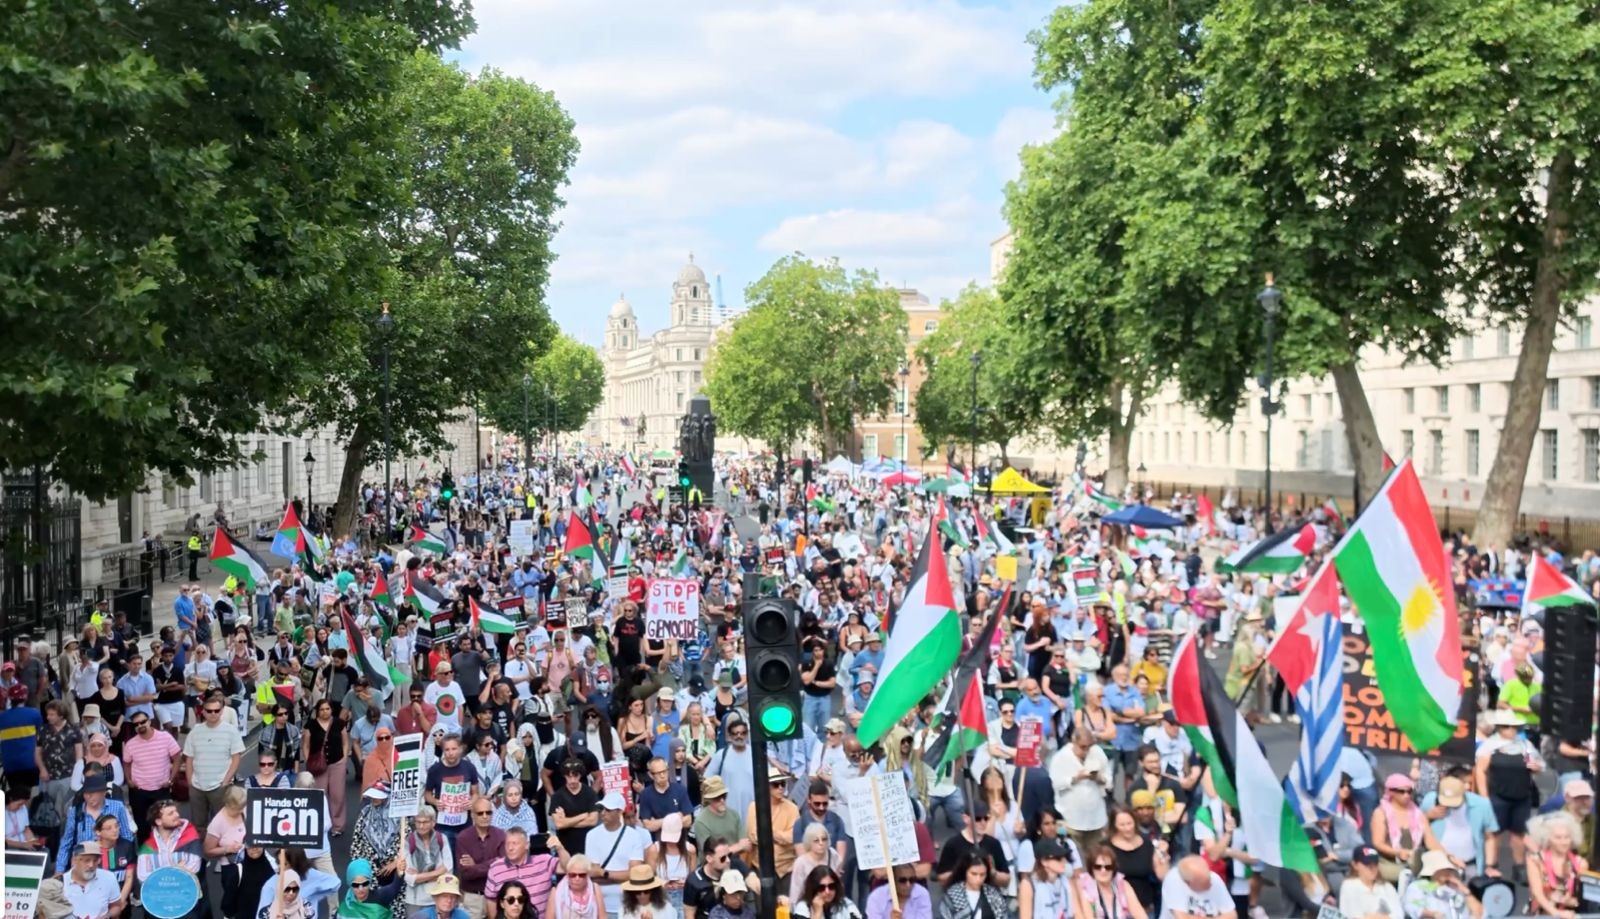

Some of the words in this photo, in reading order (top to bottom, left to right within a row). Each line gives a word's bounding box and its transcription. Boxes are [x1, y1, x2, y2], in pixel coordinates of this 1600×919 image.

[653, 583, 697, 600] STOP
[663, 601, 686, 615] THE
[648, 618, 698, 639] GENOCIDE
[392, 769, 419, 790] FREE
[391, 789, 418, 800] PALESTINE
[444, 784, 467, 794] GAZA
[264, 797, 292, 808] Hands
[293, 797, 309, 808] Off
[441, 793, 469, 804] CEASE
[252, 800, 319, 836] Iran
[444, 815, 462, 825] NOW
[16, 900, 29, 911] to
